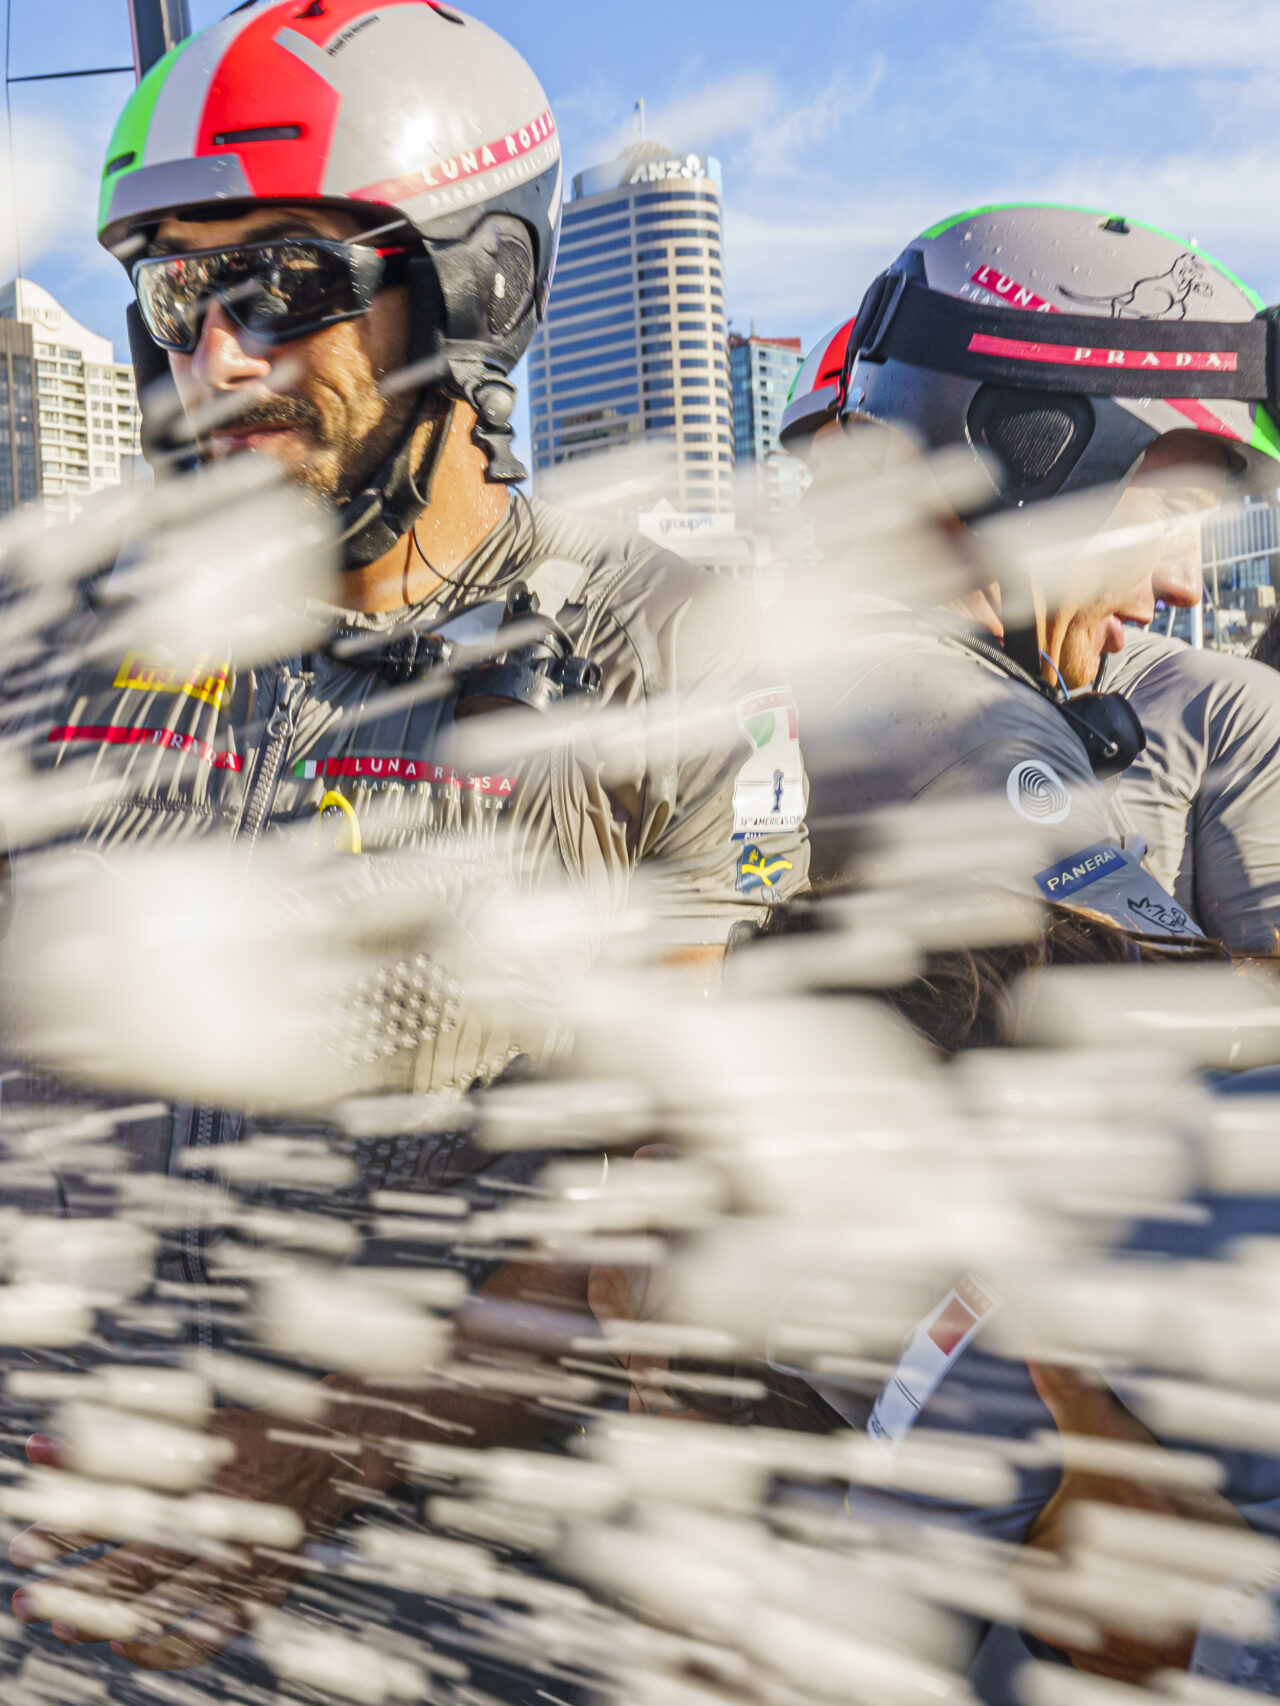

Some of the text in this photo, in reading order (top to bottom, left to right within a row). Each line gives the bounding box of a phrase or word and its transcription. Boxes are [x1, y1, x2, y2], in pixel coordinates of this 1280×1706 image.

[422, 144, 497, 187] LUNA
[629, 160, 681, 184] ANZ
[978, 266, 1052, 313] LUNA
[1074, 347, 1221, 367] PRADA
[152, 729, 236, 769] PRADA
[352, 780, 400, 792] PRADA
[355, 758, 512, 792] LUNA ROSSA
[1047, 849, 1116, 891] PANERAI
